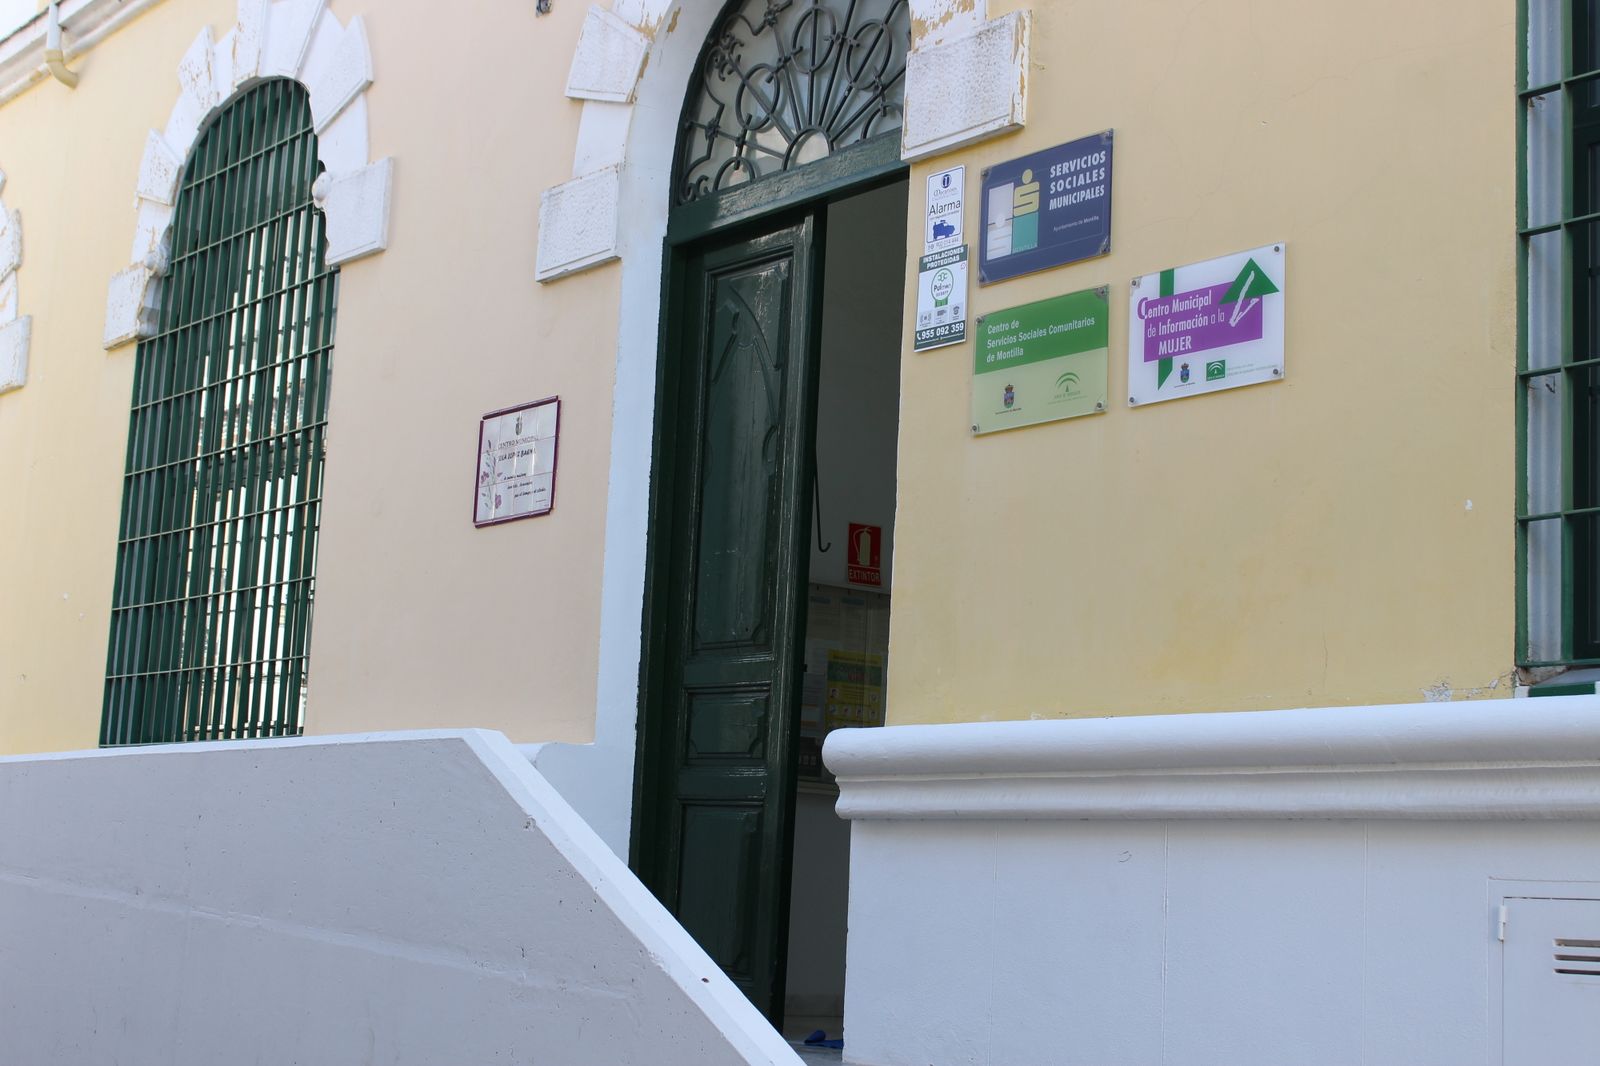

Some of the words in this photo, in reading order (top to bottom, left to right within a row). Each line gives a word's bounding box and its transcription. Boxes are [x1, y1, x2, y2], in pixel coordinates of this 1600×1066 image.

[1050, 151, 1106, 178] SERVICIOS
[1050, 168, 1105, 194] SOCIALES
[1049, 185, 1105, 211] MUNICIPALES
[929, 200, 960, 216] Alarma
[923, 247, 964, 263] INSTALACIONES
[926, 255, 960, 270] PROTEGIDAS
[1137, 297, 1170, 320] Centro
[1171, 290, 1212, 313] Municipal
[921, 329, 934, 340] 955
[936, 326, 949, 337] 092
[950, 322, 964, 334] 359
[987, 322, 1010, 335] Centro
[1011, 319, 1020, 330] de
[987, 334, 1017, 349] Servicios
[1018, 328, 1047, 342] Sociales
[1048, 316, 1095, 334] Comunitarios
[1147, 327, 1157, 338] de
[1158, 314, 1209, 336] Información
[1210, 314, 1216, 324] a
[1217, 308, 1225, 323] la
[986, 353, 995, 363] de
[996, 347, 1024, 361] Montilla
[1158, 336, 1192, 356] MUJER
[849, 568, 880, 582] EXTINTOR
